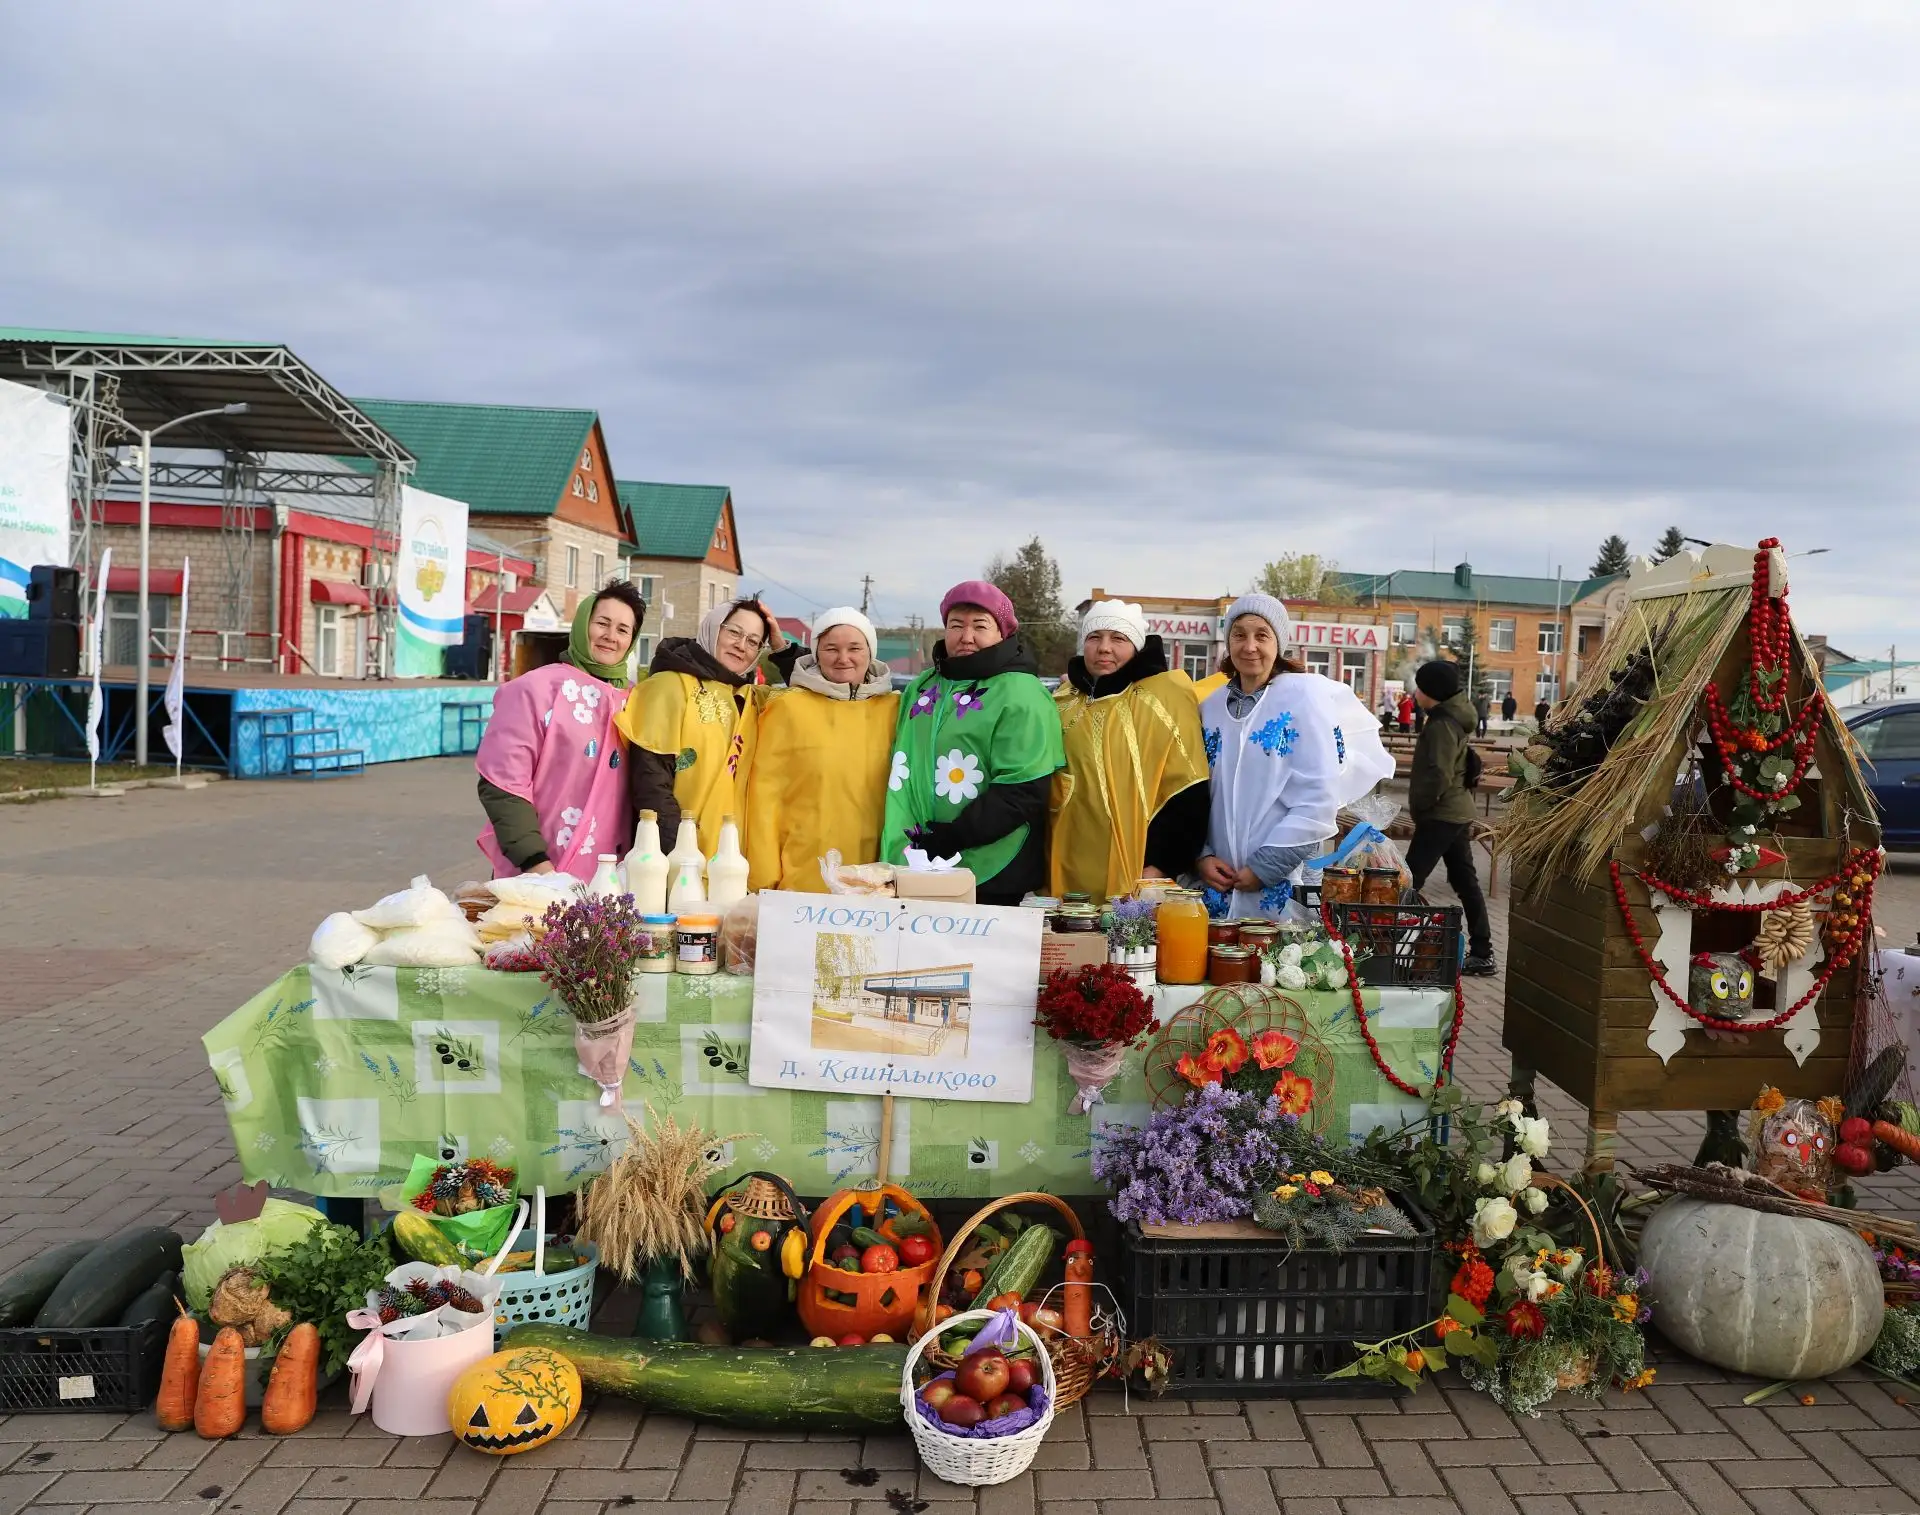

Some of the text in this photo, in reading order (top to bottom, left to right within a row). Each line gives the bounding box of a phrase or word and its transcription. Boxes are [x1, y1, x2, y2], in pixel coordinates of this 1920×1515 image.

[794, 905, 999, 937] МОБУ СОШ
[818, 1058, 997, 1091] Каинлыково
